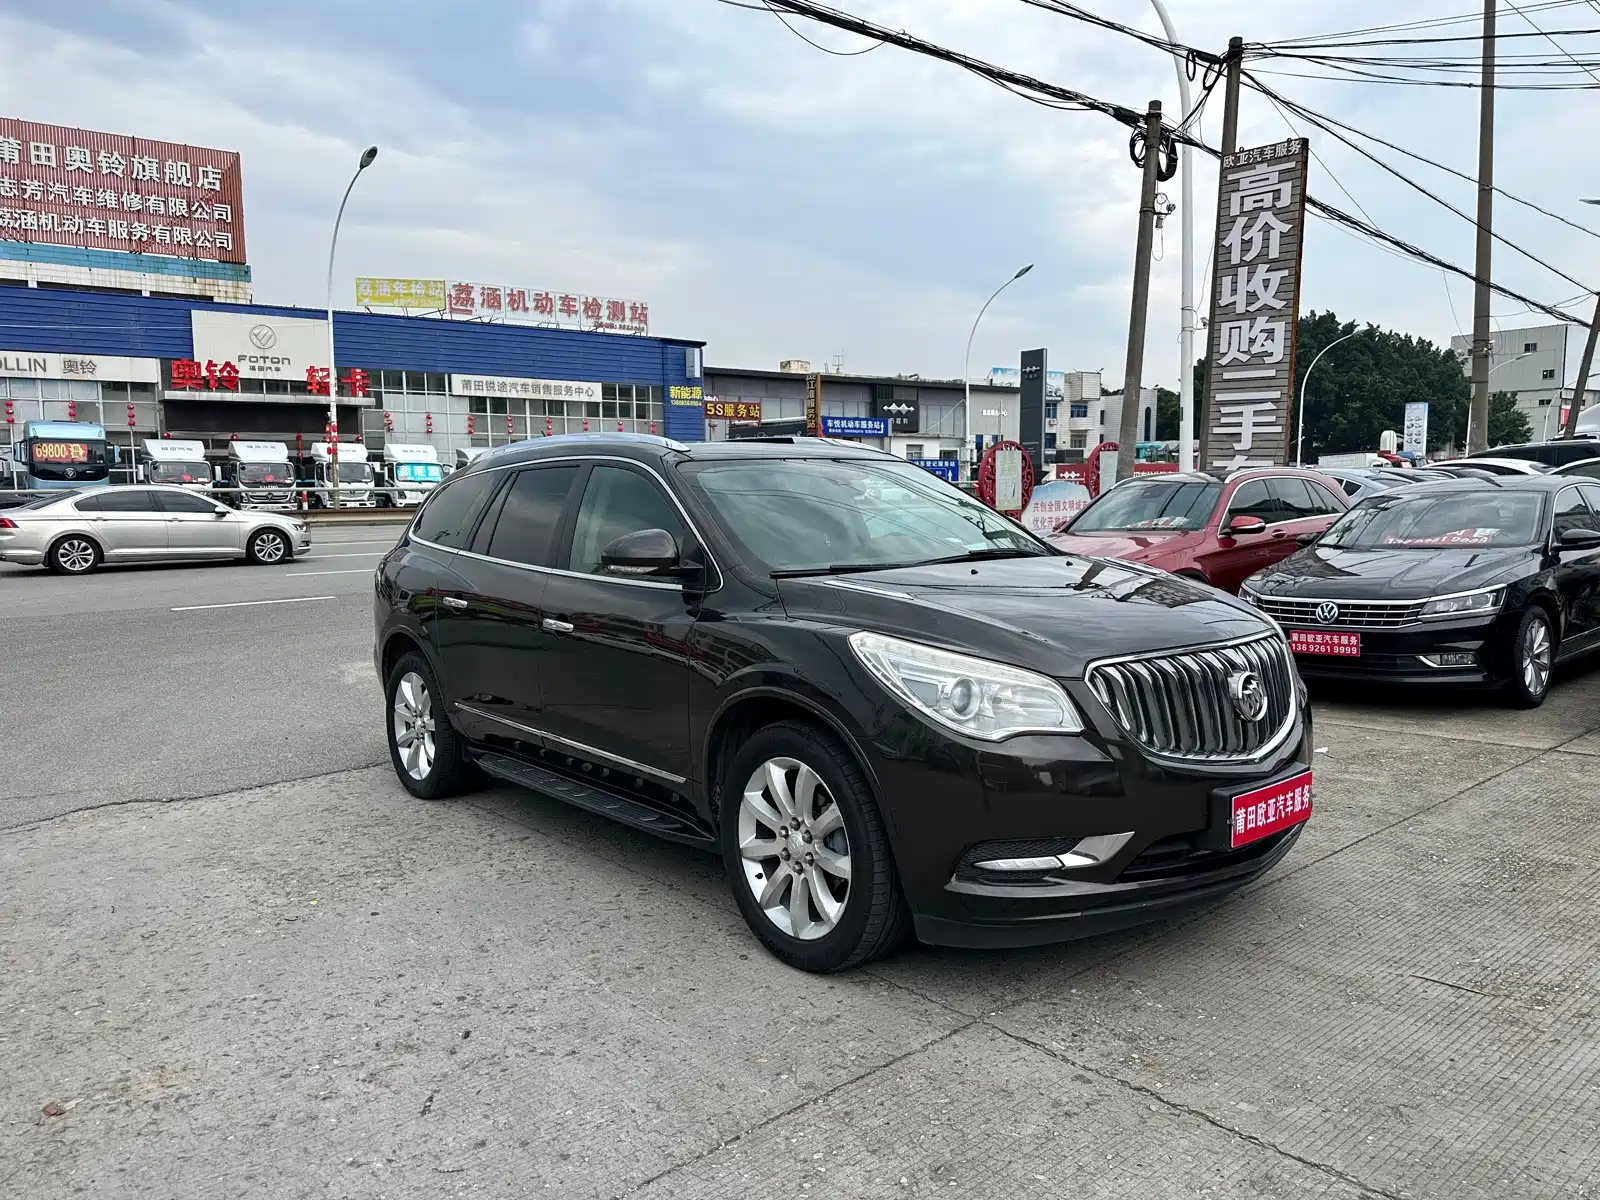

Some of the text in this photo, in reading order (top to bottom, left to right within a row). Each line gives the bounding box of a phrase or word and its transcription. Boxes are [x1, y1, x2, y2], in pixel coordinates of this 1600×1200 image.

[1223, 140, 1301, 168] 欧亚汽车服务
[453, 283, 648, 325] 荔涵机动车检测站
[1213, 162, 1296, 467] 高价收购二手
[63, 359, 97, 375] 奥铃
[170, 358, 240, 391] 奥铃
[461, 379, 595, 397] 莆田锐途汽车销售服务中心
[670, 386, 702, 399] 新能源
[707, 403, 760, 418] 5S服务站
[826, 419, 881, 429] 车悦机动车服务站
[36, 444, 67, 458] 69800
[1291, 632, 1358, 646] 莆田欧亚汽车服务
[1292, 643, 1358, 655] 136 9261 9999
[1236, 784, 1311, 836] 莆田欧亚汽车服务
